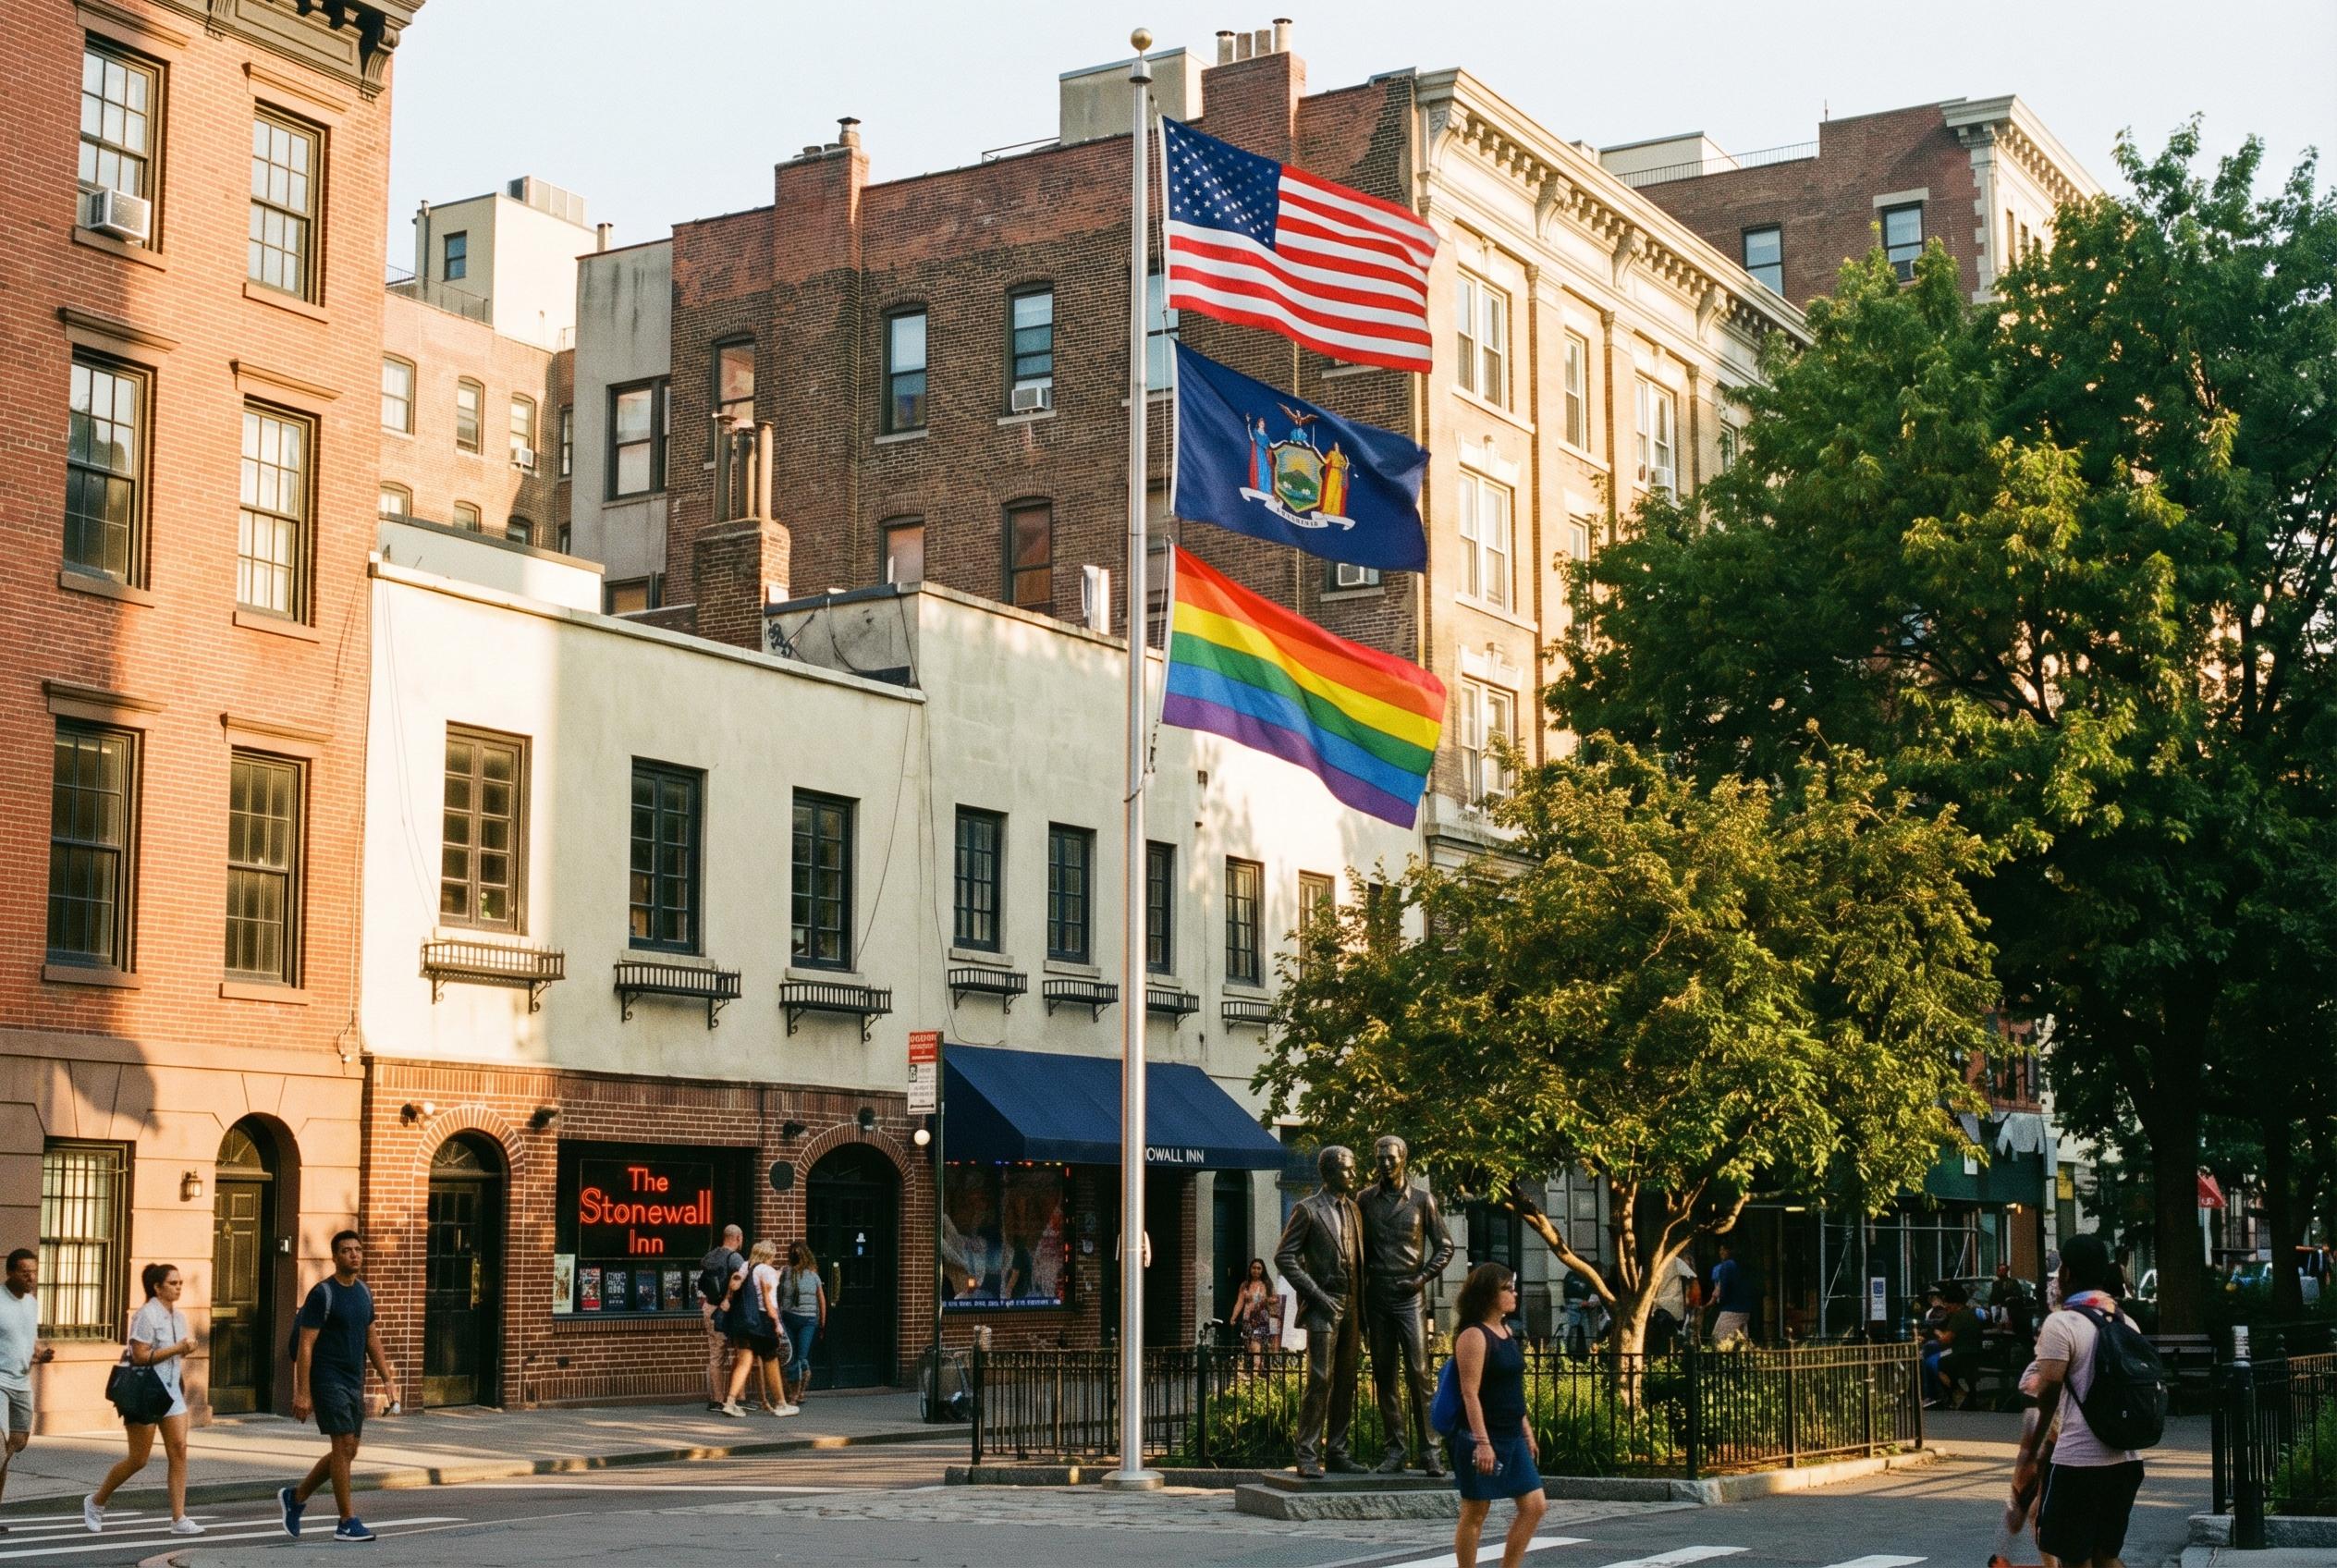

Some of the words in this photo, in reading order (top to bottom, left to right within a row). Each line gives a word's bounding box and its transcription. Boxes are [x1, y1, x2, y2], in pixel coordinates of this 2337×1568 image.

[1144, 1147, 1183, 1163] OWALL
[1186, 1148, 1205, 1163] INN
[628, 1167, 668, 1192] The
[580, 1187, 712, 1225] Stonewall
[629, 1229, 664, 1254] Inn
